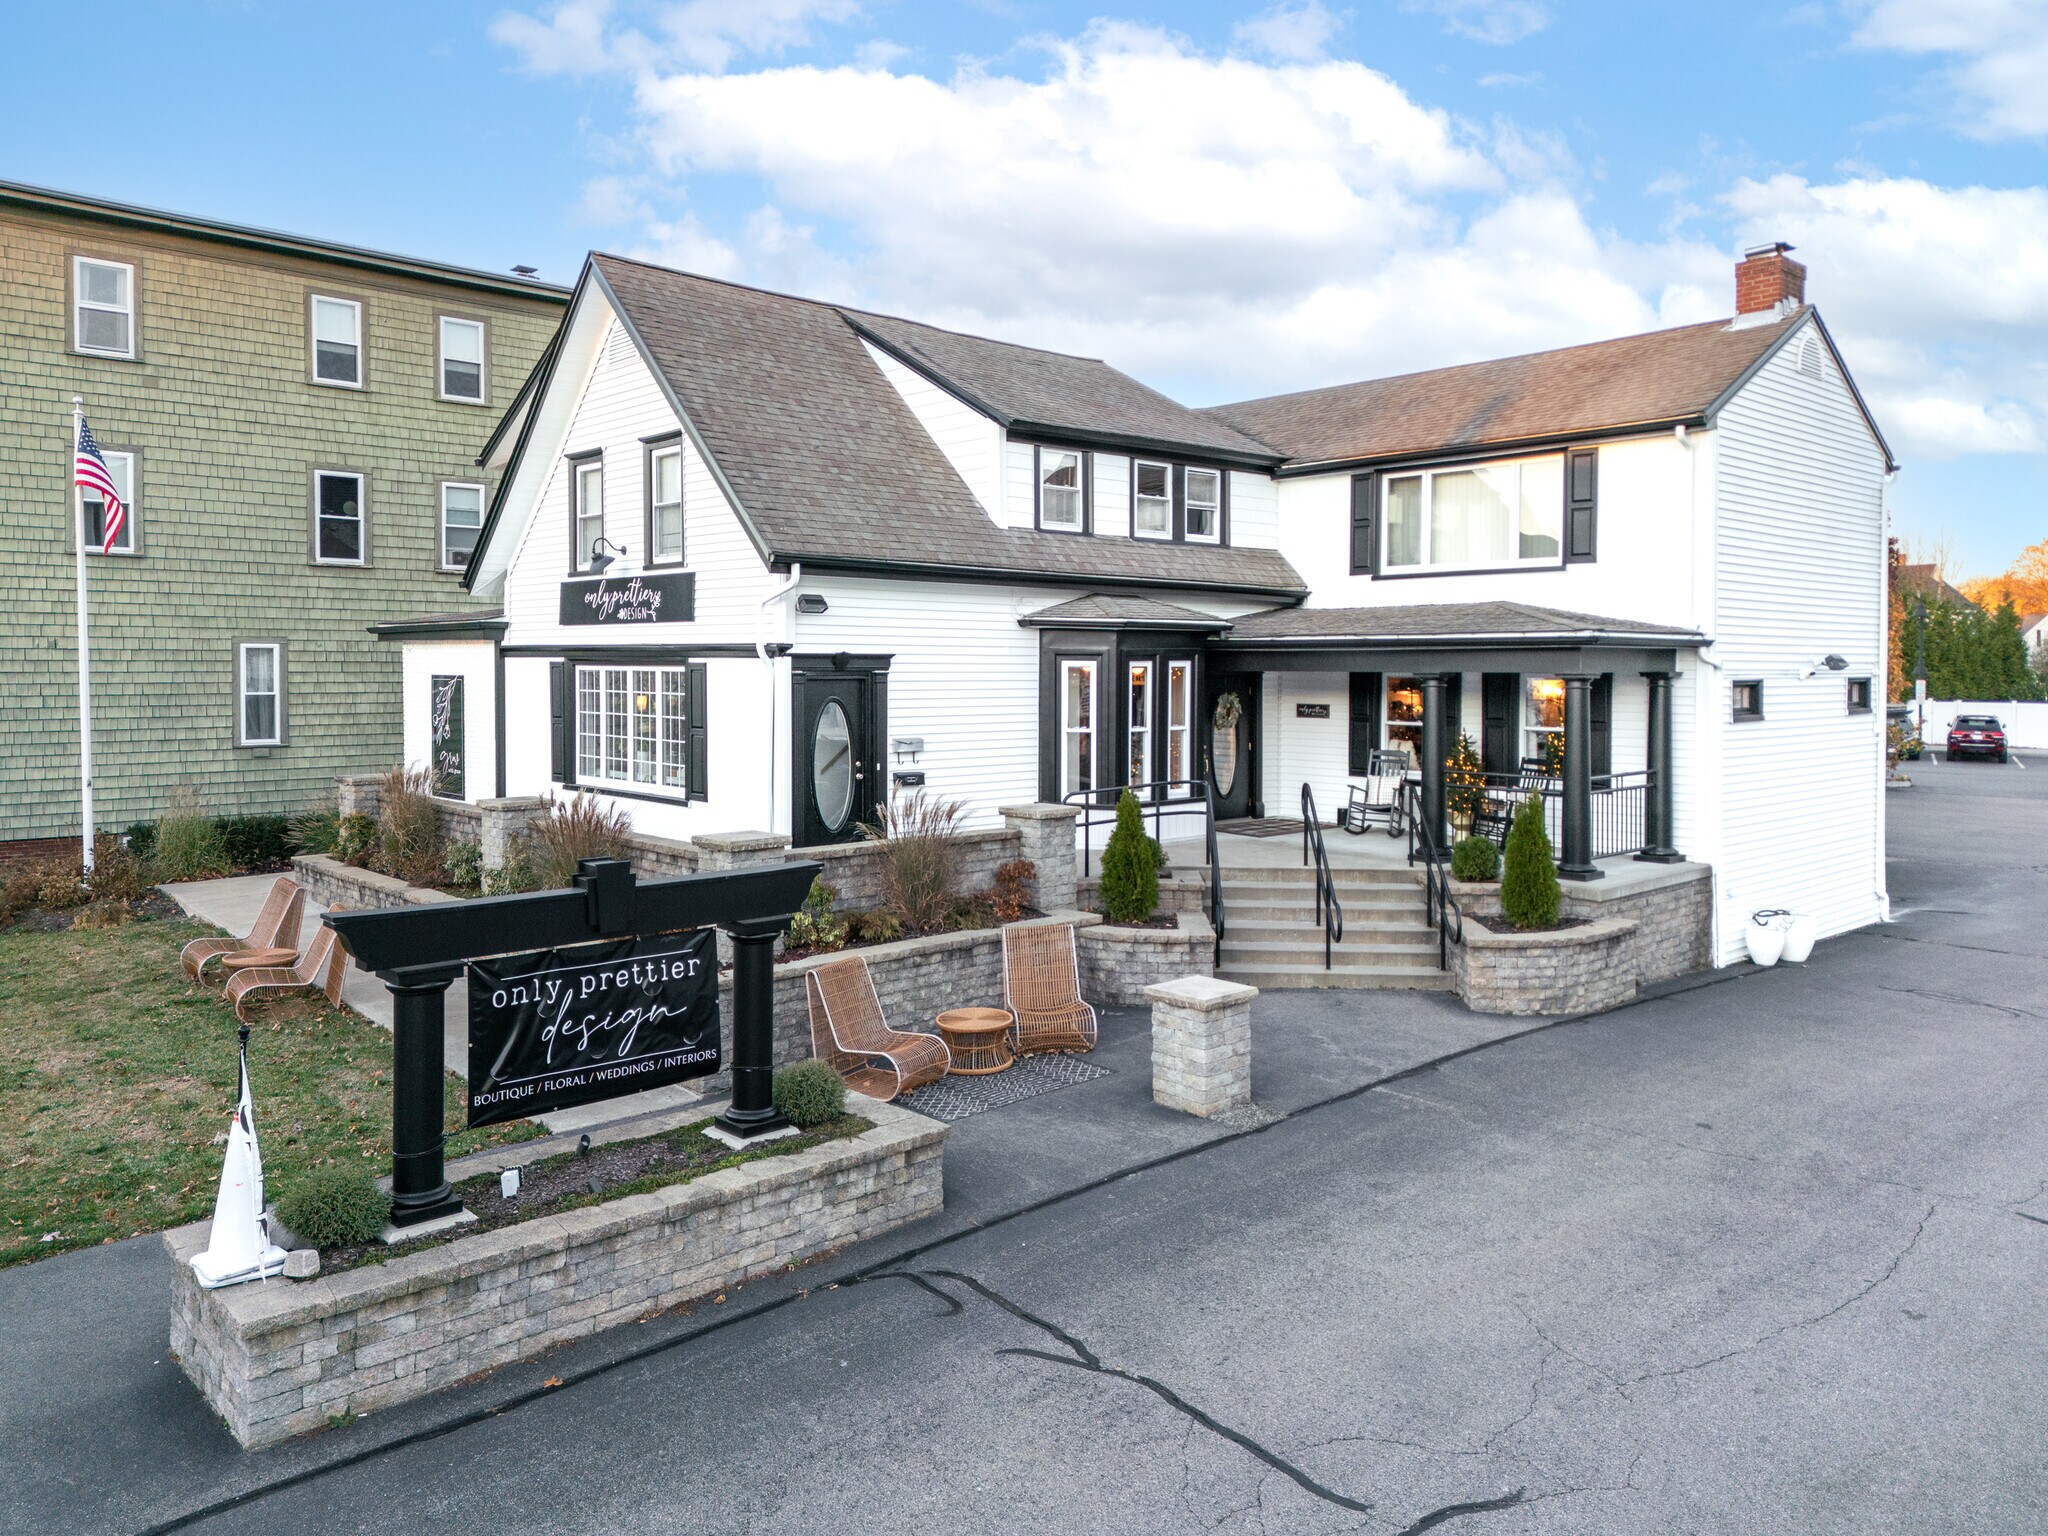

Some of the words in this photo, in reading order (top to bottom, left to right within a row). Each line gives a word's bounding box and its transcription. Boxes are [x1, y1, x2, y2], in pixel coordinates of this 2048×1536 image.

[624, 607, 647, 620] DESIGN
[492, 978, 562, 1009] only
[579, 958, 700, 999] prettier
[541, 988, 688, 1064] design
[474, 1083, 534, 1107] BOUTIQUE
[544, 1074, 587, 1092] FLORAL
[596, 1060, 655, 1081] WEDDINGS
[664, 1049, 717, 1068] INTERIORS
